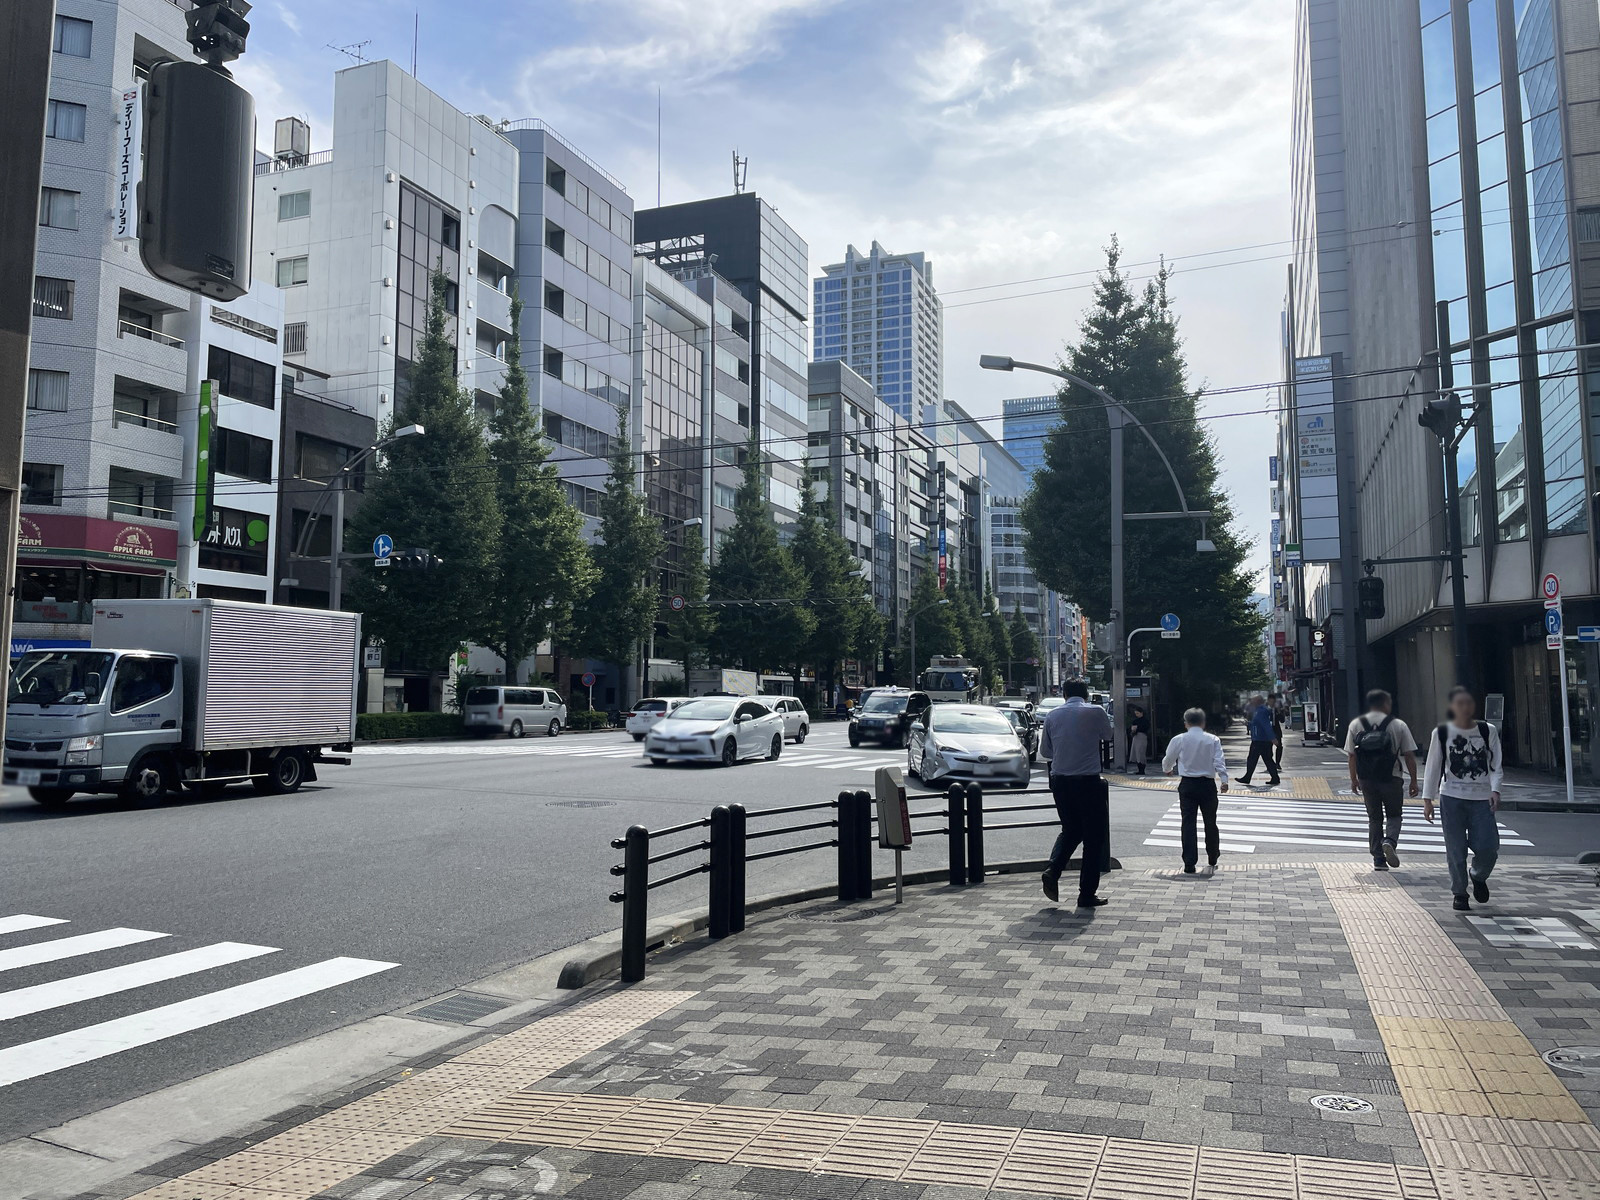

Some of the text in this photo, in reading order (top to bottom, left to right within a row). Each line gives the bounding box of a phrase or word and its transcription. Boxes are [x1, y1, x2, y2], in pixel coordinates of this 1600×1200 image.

[118, 103, 134, 235] デイリーフーズコーポレーション
[223, 526, 242, 547] ハウス
[113, 545, 153, 556] APPLE FARM
[1546, 581, 1556, 592] 30
[673, 599, 681, 607] 50
[1549, 616, 1555, 631] P
